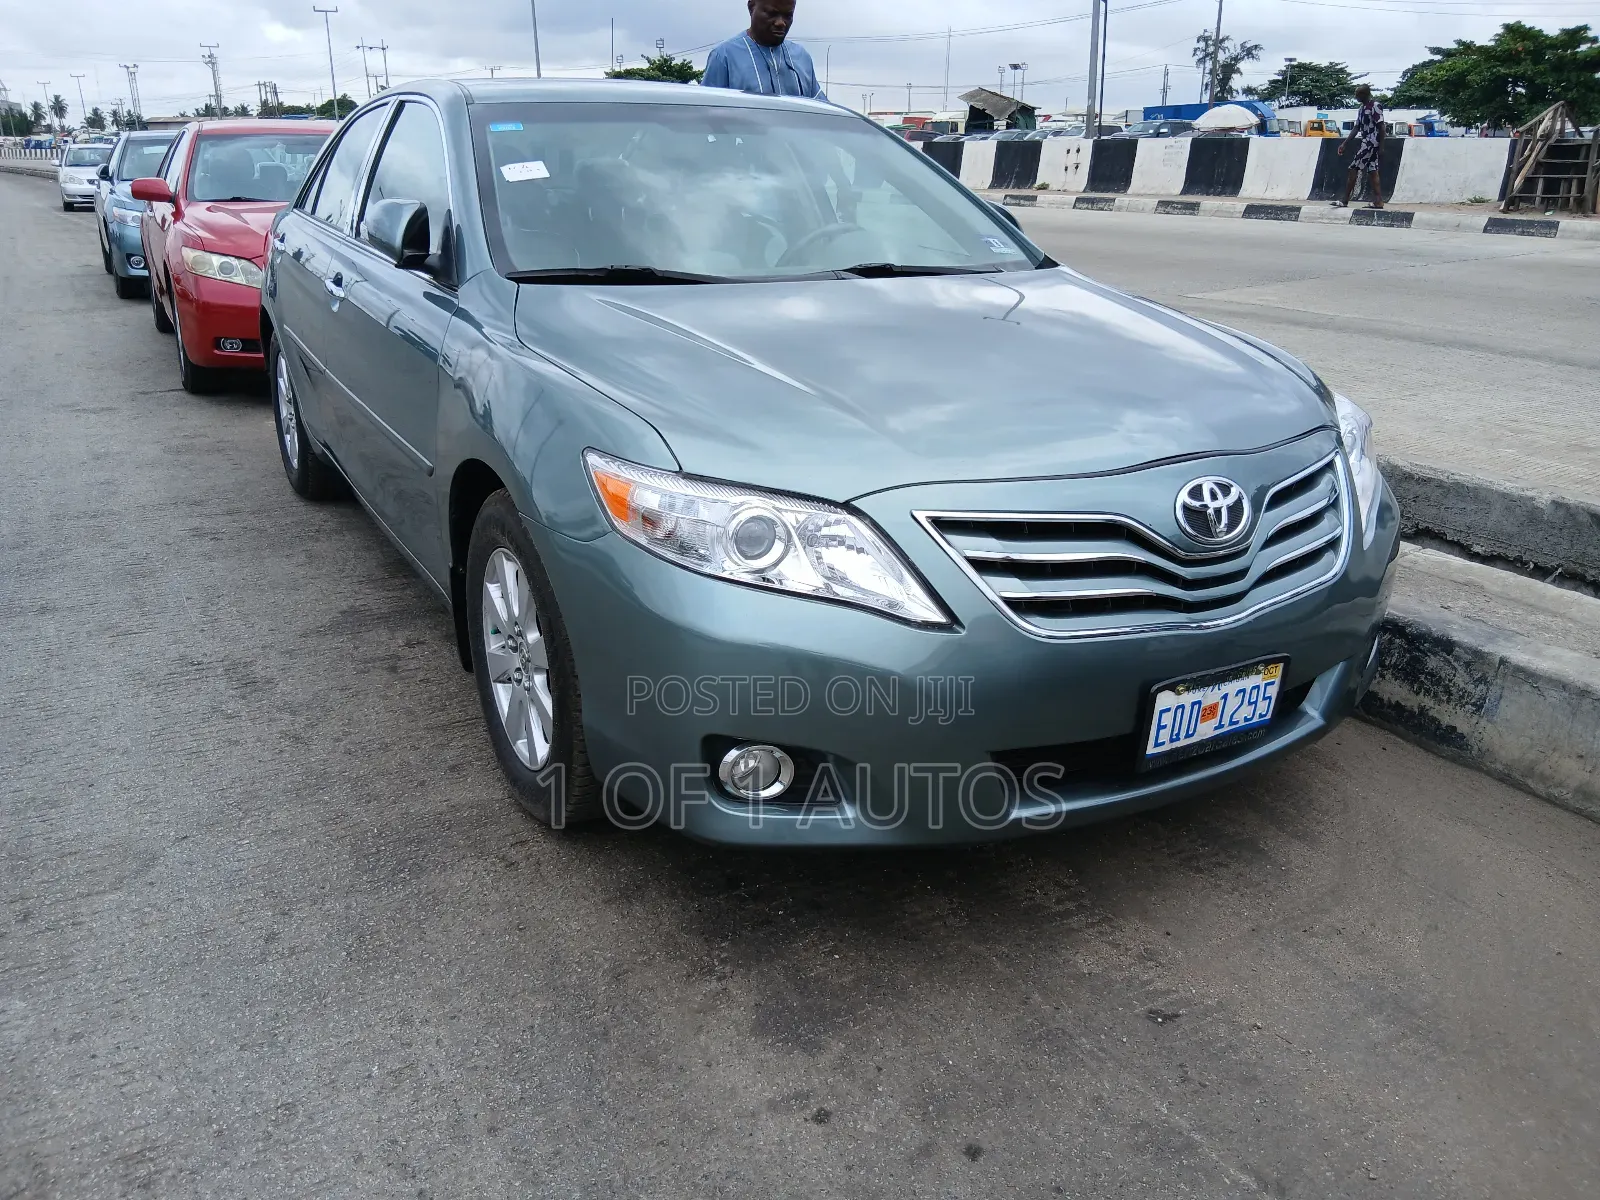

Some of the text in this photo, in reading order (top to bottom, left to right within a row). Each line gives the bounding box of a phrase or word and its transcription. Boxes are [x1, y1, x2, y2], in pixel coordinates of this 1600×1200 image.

[1263, 665, 1279, 677] OCT
[1153, 698, 1202, 749] EQD
[1213, 680, 1276, 732] 1295
